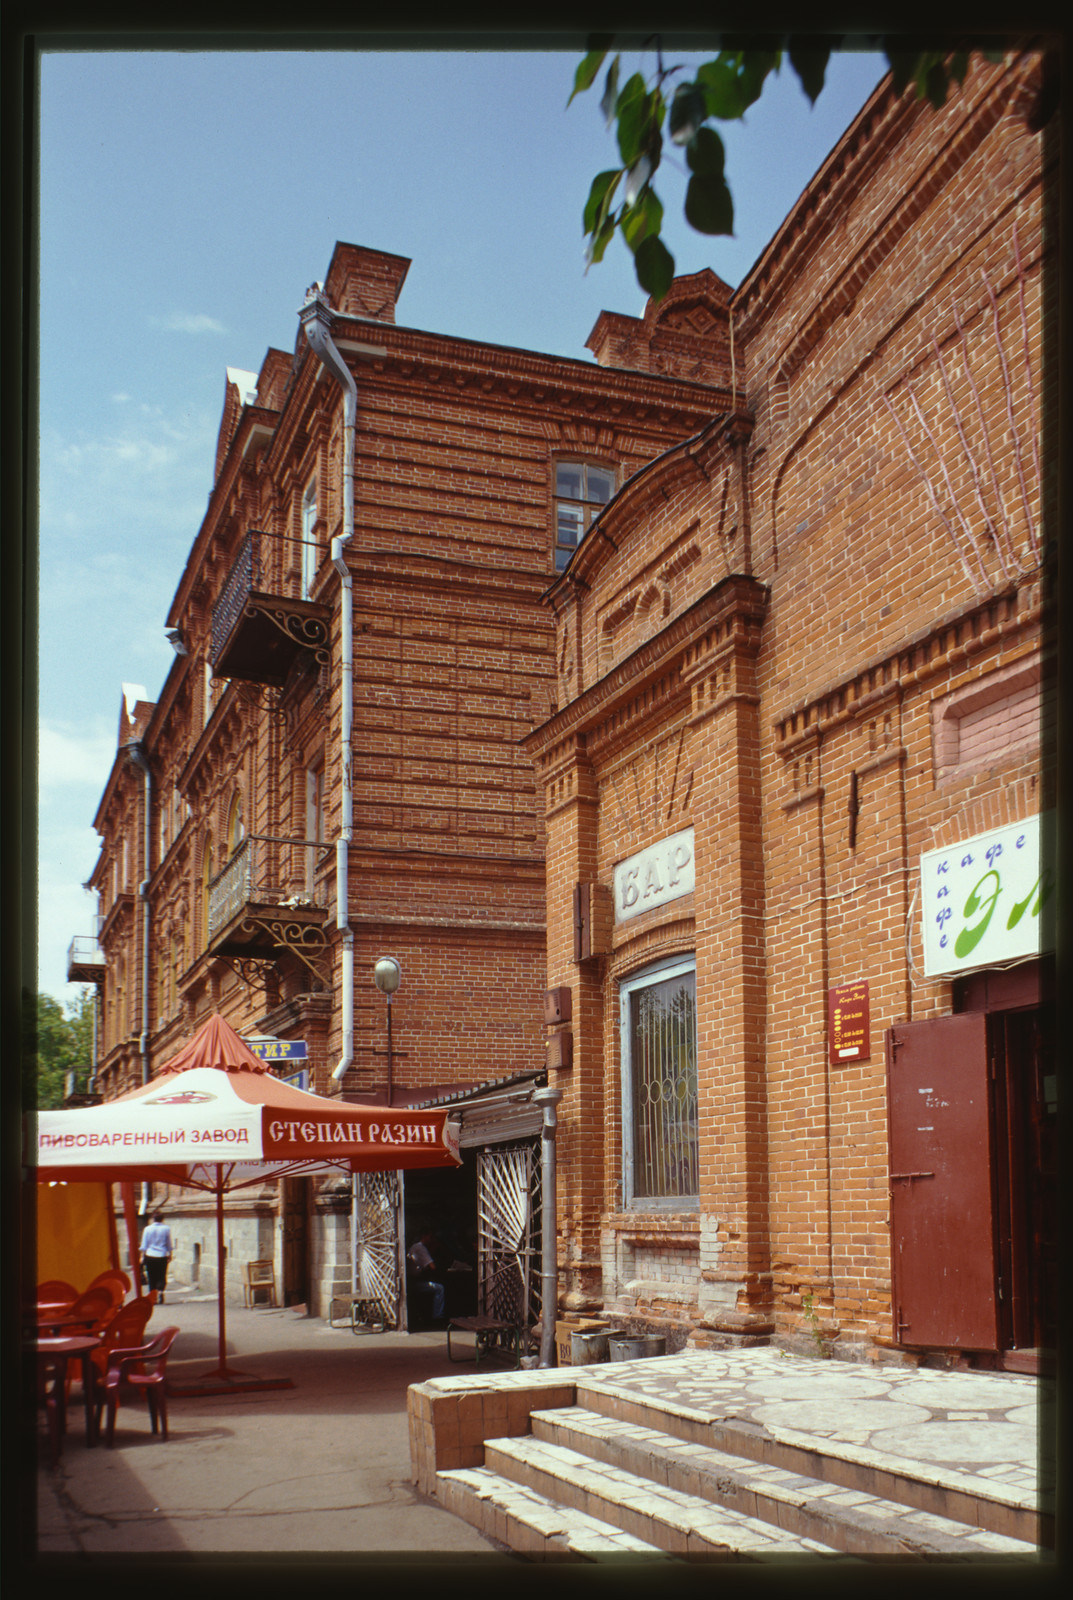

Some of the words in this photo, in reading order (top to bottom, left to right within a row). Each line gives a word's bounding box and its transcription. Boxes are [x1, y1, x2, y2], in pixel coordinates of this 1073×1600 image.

[937, 834, 1026, 875] кафе
[621, 844, 691, 909] БАР
[247, 1043, 291, 1058] ТИР
[39, 1129, 185, 1147] ПИВОВАРЕННЫЙ
[190, 1128, 249, 1143] ЗАВОД
[269, 1121, 363, 1143] СТЕПАН
[368, 1123, 436, 1144] РАЗИН
